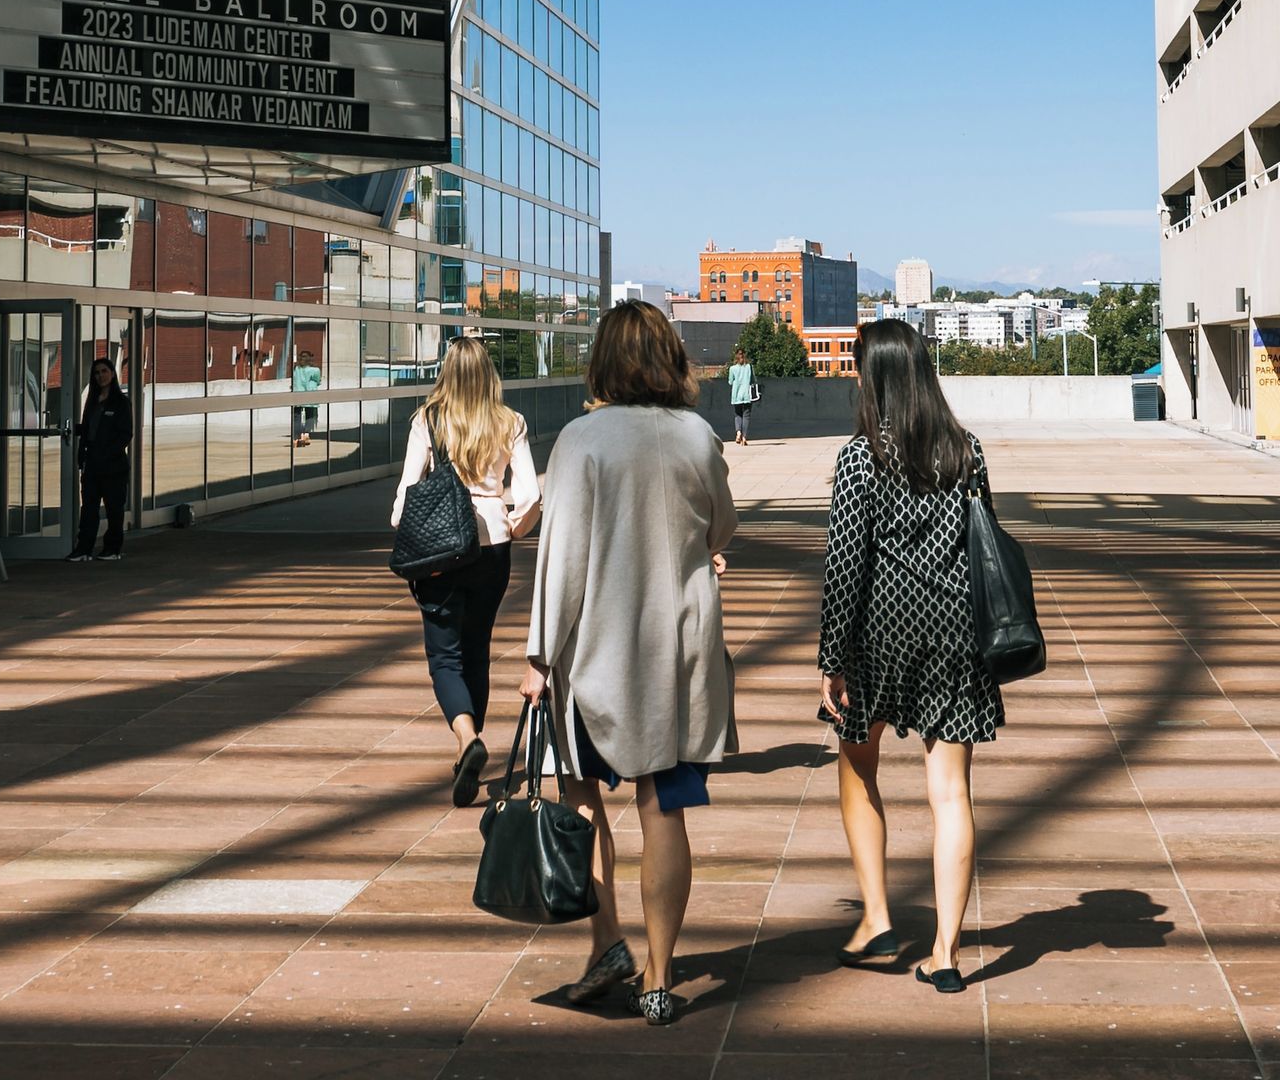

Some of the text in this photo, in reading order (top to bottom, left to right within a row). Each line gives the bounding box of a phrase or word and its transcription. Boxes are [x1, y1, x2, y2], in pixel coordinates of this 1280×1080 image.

[81, 7, 314, 60] 2023 LUDEMAN CENTER
[59, 42, 338, 95] ANNUAL COMMUNITY EVENT
[25, 75, 354, 131] FEATURING SHANKAR VEDANTAM
